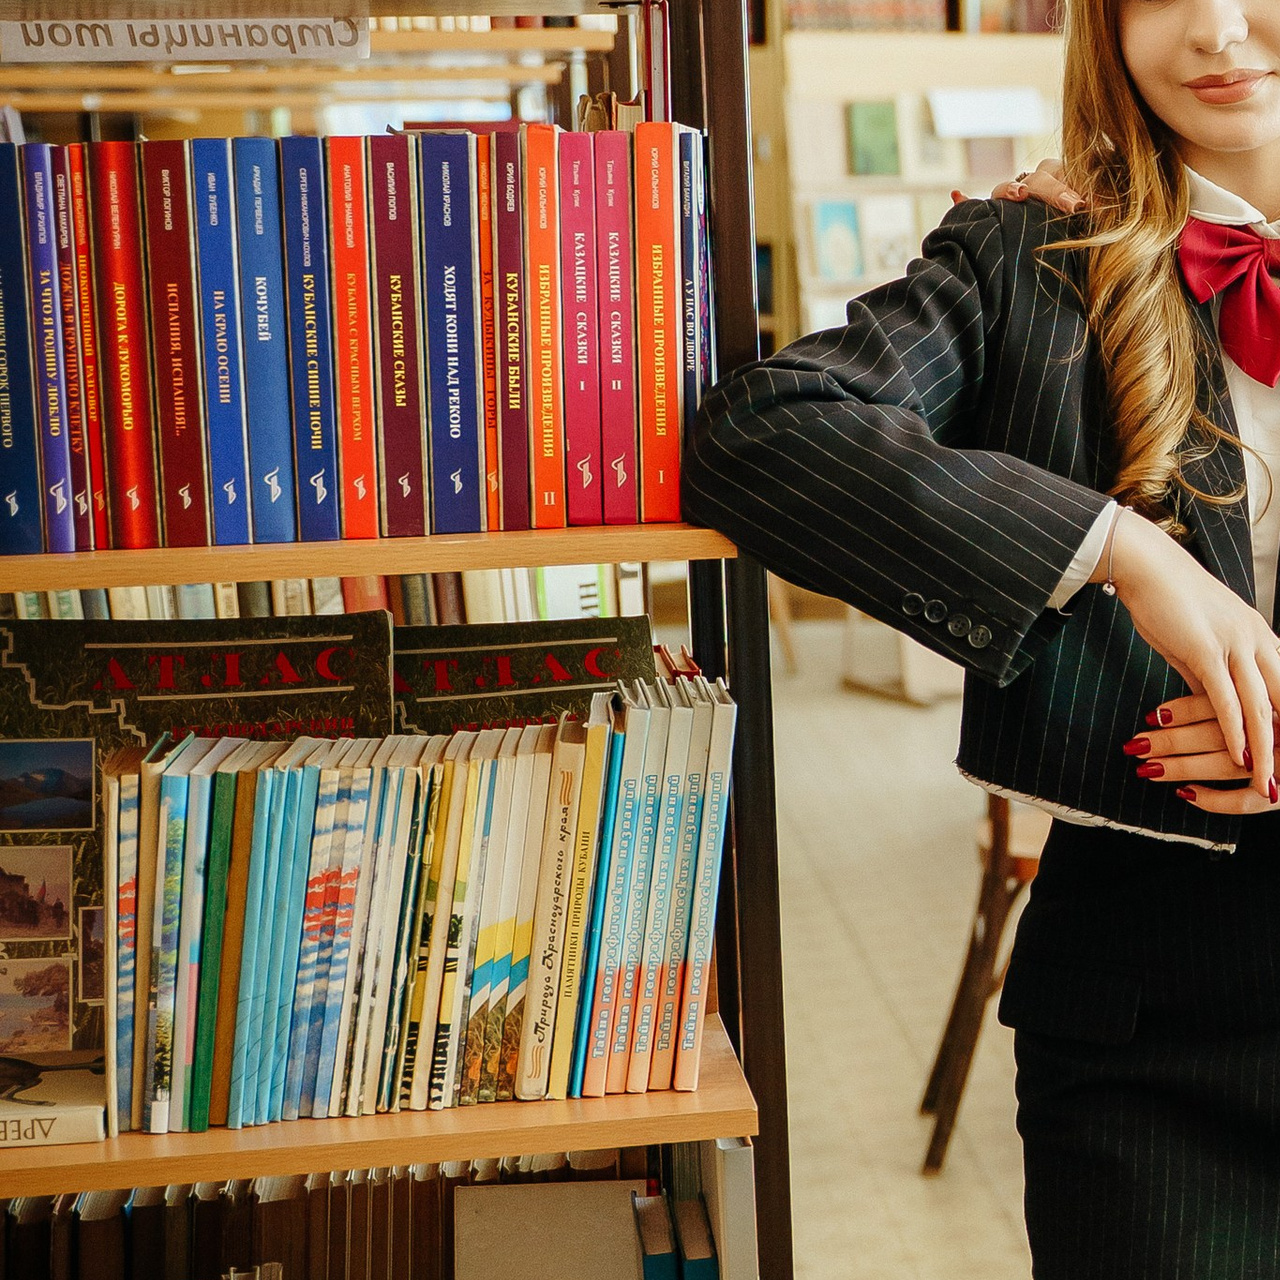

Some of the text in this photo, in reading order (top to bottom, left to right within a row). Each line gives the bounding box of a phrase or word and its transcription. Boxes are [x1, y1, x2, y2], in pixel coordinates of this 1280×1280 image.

[56, 174, 68, 248] СВЕТЛАНА МАКАРОВА
[109, 171, 120, 204] НИКОЛАЙ
[162, 169, 173, 231] ВИКТОР ЛОГИНОВ
[207, 172, 218, 226] ИВАН ЗУБЕНКО
[253, 165, 262, 195] АРКАДИЙ
[299, 167, 308, 193] СЕРГЕЙ
[343, 164, 355, 248] АНАТОЛИЙ ЗНАМЕНСКИЙ
[386, 162, 397, 221] ВАСИЛИЙ ПОПОВ
[442, 161, 452, 227] НИКОЛАЙ КРАСНОВ
[506, 162, 515, 212] ЮРИЙ БОДЯЕВ
[539, 189, 547, 229] САЛЬНИКОВ
[572, 189, 581, 207] Кулик
[606, 189, 615, 207] Кулик
[651, 147, 659, 209] ЮРИЙ САЛЬНИКОВ
[255, 277, 272, 341] КОЧУБЕЙ
[539, 264, 552, 346] ИЗБРАННЫЕ
[573, 233, 588, 364] КАЗАЦКИЕ СКАЗКИ
[608, 232, 622, 302] КАЗАЦКИЕ
[39, 269, 60, 436] ЗА ЧТО РОДИНУ ЛЮБЛЮ
[79, 254, 97, 422] НЕОКОНЧЕННЫЙ РАЗГОВОР
[113, 282, 134, 431] ДОРОГА ЛУКОМОРЬЮ
[167, 283, 186, 437] ИСПАНИЯ, ИСПАНИЯ!..
[213, 290, 231, 404] НА КРАЮ ОСЕНИ
[302, 274, 323, 450] КУБАНСКИЕ СИНИЕ НОЧИ
[346, 273, 362, 441] КУБАНКА КРАСНЫМ ВЕРХОМ
[389, 275, 407, 408] КУБАНСКИЕ СКАЗЫ
[443, 265, 461, 439] ХОДЯТ КОНИ НАД РЕКОЮ
[505, 272, 521, 410] КУБАНСКИЕ БЫЛИ
[610, 311, 622, 364] СКАЗКИ
[652, 244, 667, 437] ИЗБРАННЫЕ ПРОИЗВЕДЕНИЯ
[685, 298, 696, 372] НАС ВО ДВОРЕ
[64, 327, 83, 456] КРУПНУЮ КЛЕТКУ
[487, 390, 498, 429] ГОРЫ
[541, 349, 554, 457] ПРОИЗВЕДЕНИЯ
[92, 646, 356, 691] АТЛАС
[533, 805, 571, 1044] Природа Краснодарского края
[564, 831, 591, 998] ПАМЯТНИКИ ПРИРОДЫ КУБАНИ
[592, 778, 636, 1058] Тайна географических названий
[613, 774, 658, 1053] Тайна географических названий
[635, 774, 680, 1053] Тайна географических названий
[658, 773, 701, 1051] Тайна географических названий
[682, 771, 723, 1050] Тайна географических названий
